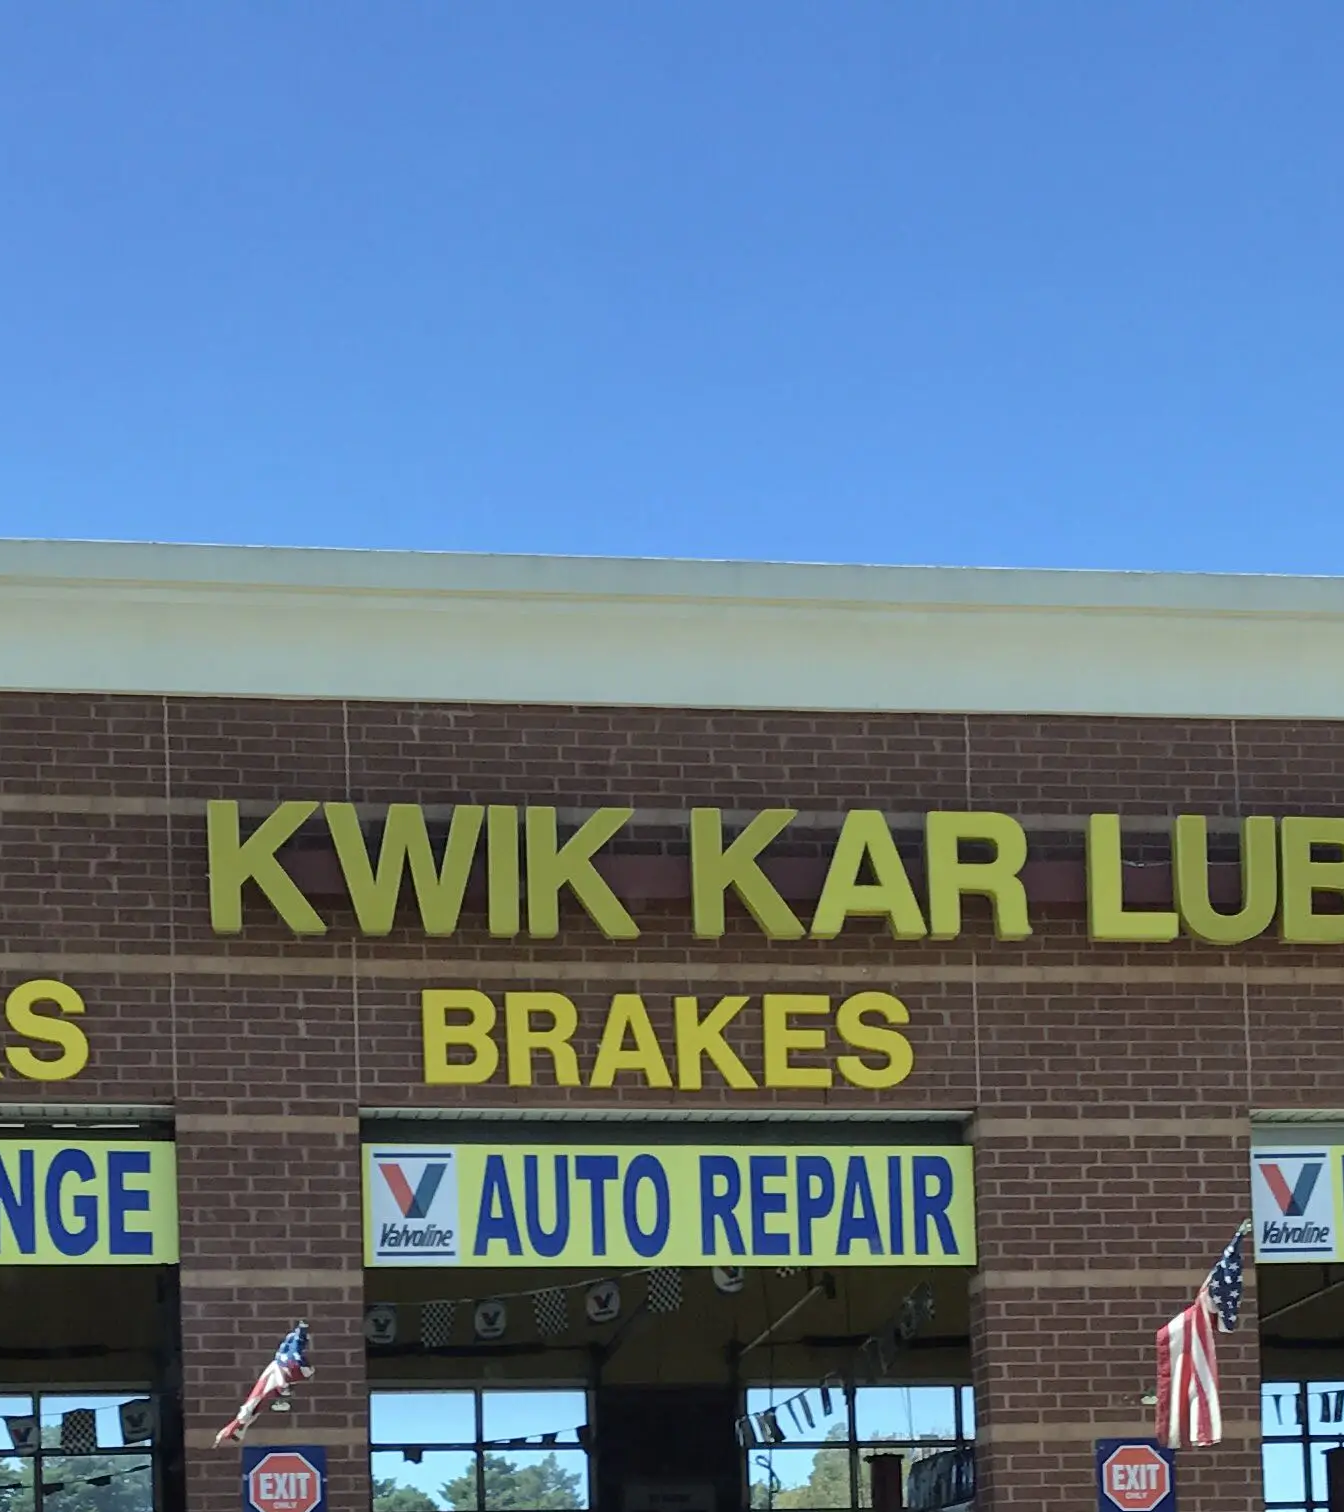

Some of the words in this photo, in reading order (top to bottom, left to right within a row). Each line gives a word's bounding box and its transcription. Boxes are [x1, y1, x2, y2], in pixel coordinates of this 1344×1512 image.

[208, 800, 641, 938] KWIK
[690, 808, 1031, 941] KAR
[420, 989, 915, 1091] BRAKES
[472, 1153, 670, 1257] AUTO
[698, 1155, 960, 1256] REPAIR
[380, 1222, 454, 1247] Valvoline
[1261, 1220, 1330, 1244] Valvoline
[259, 1473, 311, 1500] EXIT
[1112, 1464, 1160, 1490] EXIT
